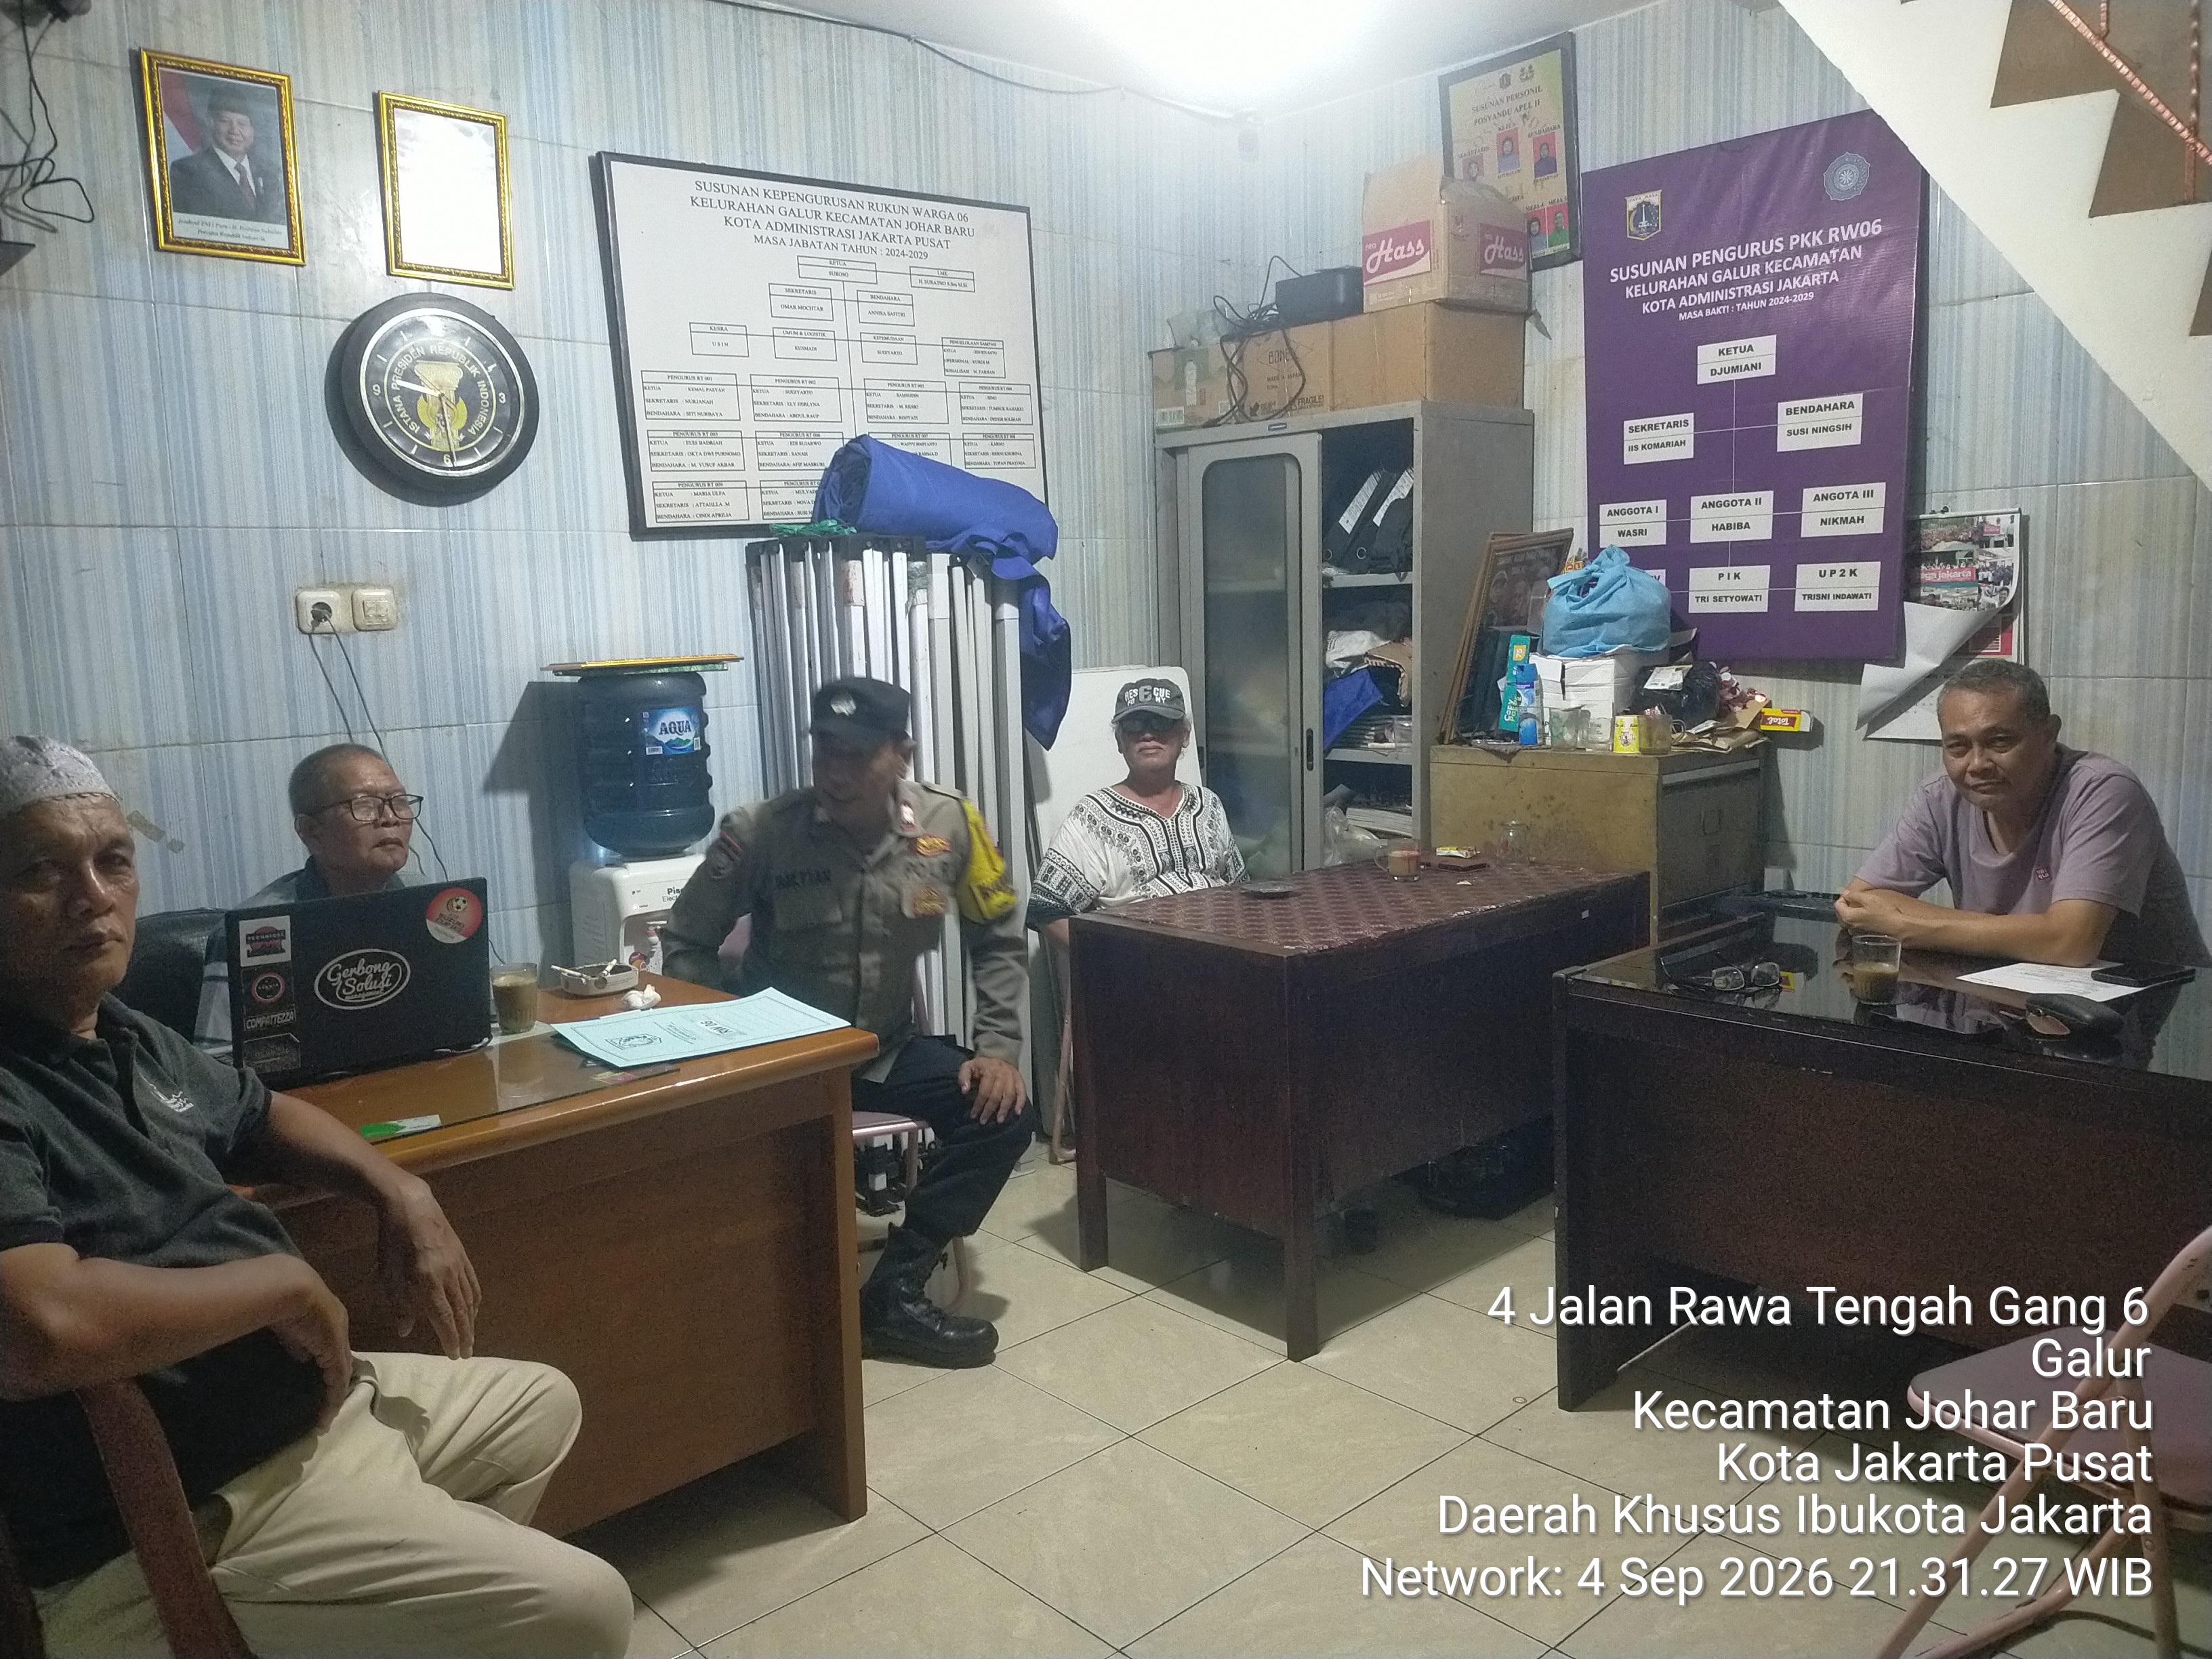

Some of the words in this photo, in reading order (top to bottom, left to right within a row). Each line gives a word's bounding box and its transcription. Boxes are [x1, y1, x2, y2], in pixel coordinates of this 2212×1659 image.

[1506, 85, 1543, 102] PERSONIL
[1474, 109, 1513, 126] POSYANDU
[1514, 101, 1533, 114] APEL
[695, 180, 759, 197] SUSUNAN
[763, 188, 864, 209] KEPENGURUSAN
[868, 202, 909, 215] RUKUN
[913, 207, 954, 220] WARGA
[957, 213, 968, 222] 06
[690, 196, 775, 215] KELURAHAN
[779, 207, 822, 220] GALUR
[826, 211, 902, 229] KECAMATAN
[905, 221, 941, 233] JOHAR
[944, 225, 975, 237] BARU
[724, 216, 761, 230] KOTA
[765, 222, 855, 239] ADMINISTRASI
[859, 230, 912, 245] JAKARTA
[915, 237, 951, 249] PUSAT
[754, 234, 787, 246] MASA
[789, 239, 839, 251] JABATAN
[841, 243, 877, 255] TAHUN
[886, 248, 928, 260] 2024-2029
[1484, 234, 1525, 264] Hass
[1610, 255, 1687, 283] SUSUNAN
[1692, 237, 1784, 268] PENGURUS
[1790, 230, 1824, 251] PKK
[1828, 219, 1883, 243] RW06
[1366, 238, 1425, 274] Hass
[1625, 274, 1708, 298] KELURAHAN
[1712, 266, 1761, 283] GALUR
[1764, 245, 1862, 274] KECAMATAN
[1642, 299, 1676, 314] KOTA
[1679, 283, 1774, 308] ADMINISTRASI
[1777, 270, 1839, 292] JAKARTA
[1679, 310, 1703, 321] MASA
[1705, 306, 1729, 316] BAKTI
[1736, 300, 1766, 312] TAHUN
[1768, 291, 1814, 306] 2024-2029
[1718, 344, 1754, 356] KETUA
[391, 346, 426, 391] PRESIDEN
[430, 344, 480, 378] REPUBLIK
[1710, 362, 1762, 376] DJUMIANI
[498, 392, 506, 404] 3
[1298, 395, 1324, 407] FRAGILE!
[392, 396, 421, 434] ISTANA
[466, 380, 490, 436] INDONESIA
[1785, 401, 1856, 417] BENDAHARA
[1628, 418, 1689, 434] SEKRETARIS
[1786, 427, 1809, 437] SUSI
[1811, 424, 1853, 435] NINGSIH
[1628, 443, 1639, 452] IIS
[1641, 439, 1686, 450] KOMARIAH
[443, 453, 451, 464] 6
[1700, 498, 1753, 510] ANGGOTA
[1755, 497, 1762, 506] II
[1813, 490, 1861, 502] ANGOTA
[1862, 489, 1875, 499] III
[1606, 506, 1653, 517] ANGGOTA
[1654, 506, 1659, 514] I
[1711, 521, 1750, 531] HABIBA
[1820, 516, 1865, 527] NIKMAH
[1617, 528, 1647, 537] WASRI
[1938, 569, 1972, 581] jakarta
[1695, 594, 1710, 602] TRI
[1713, 594, 1762, 603] SETYOWATI
[1802, 592, 1830, 601] TRISNI
[1832, 592, 1872, 601] INDAWATI
[1153, 687, 1170, 699] CUE
[659, 720, 692, 736] AQUA
[1767, 716, 1790, 726] Total
[327, 958, 391, 987] Gerbong
[342, 973, 392, 996] Solusi
[246, 1010, 295, 1030] COMPATTEZZA
